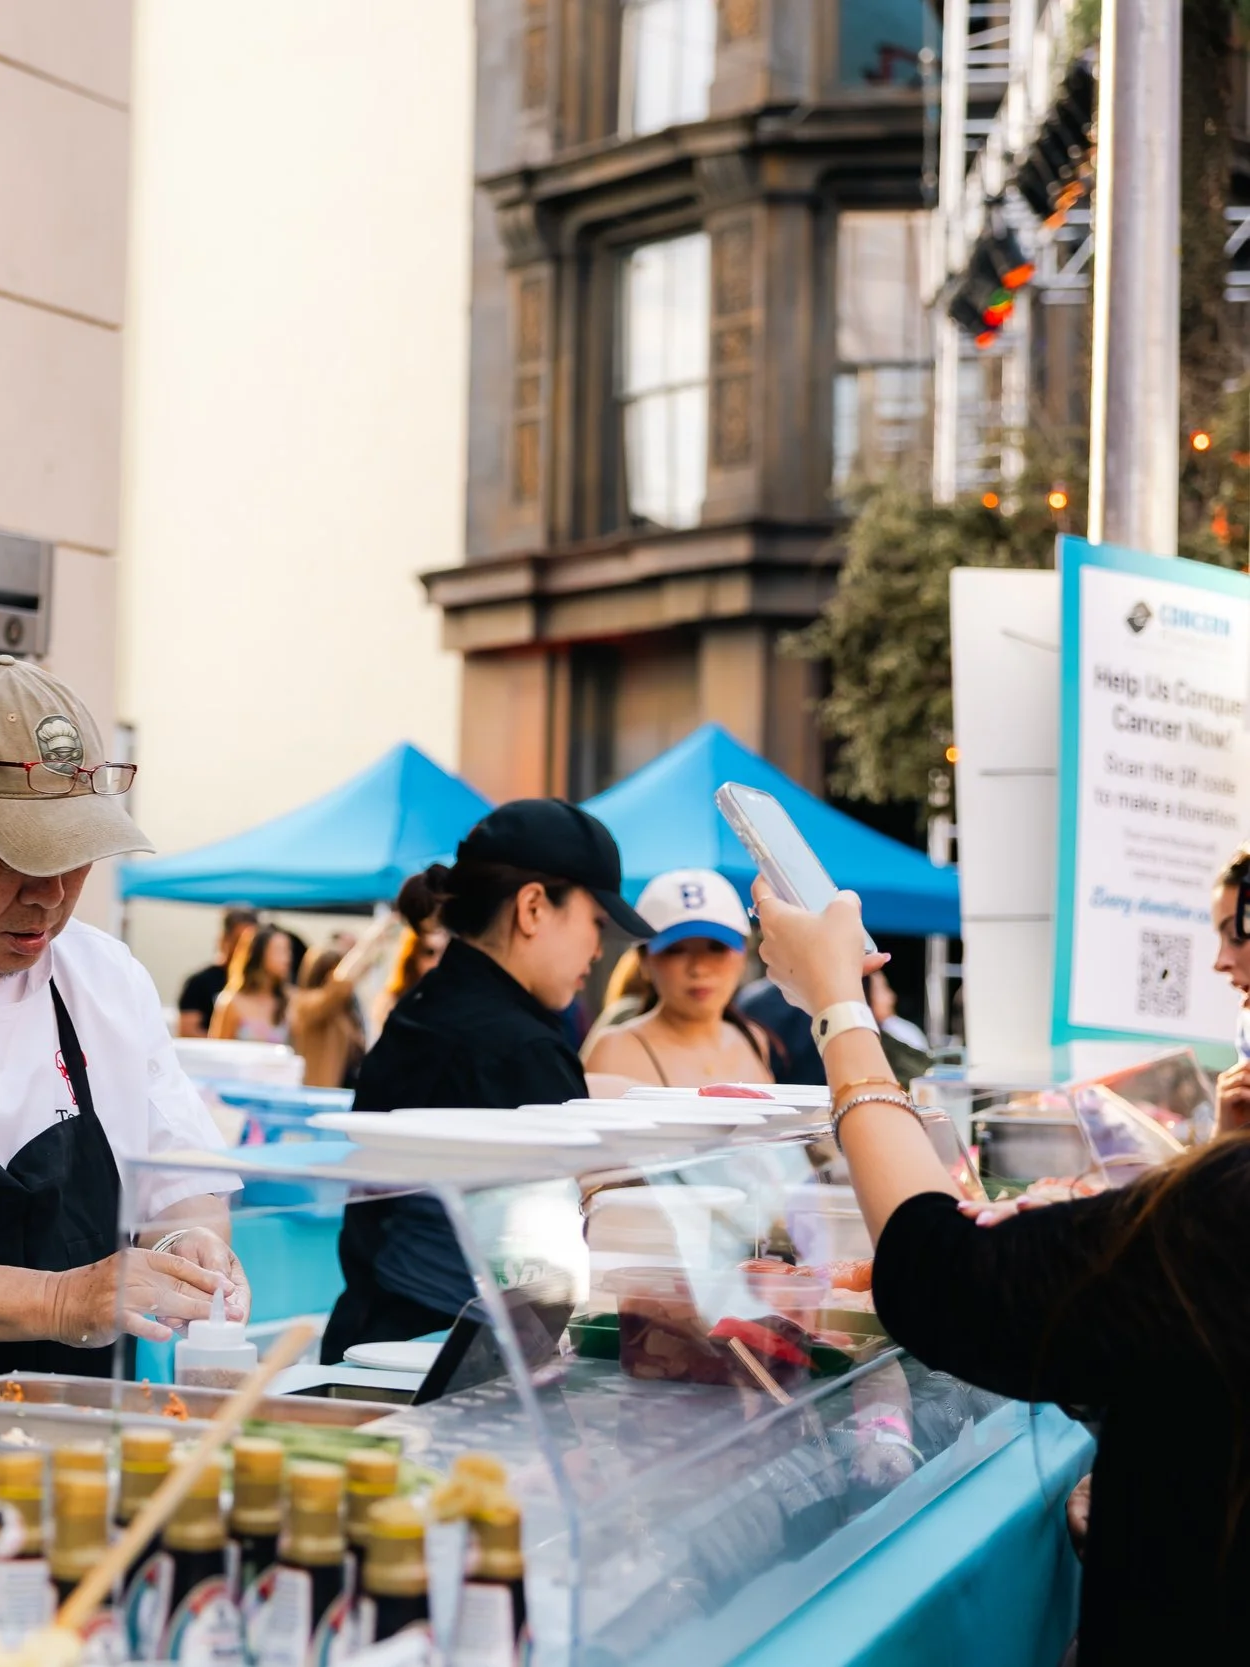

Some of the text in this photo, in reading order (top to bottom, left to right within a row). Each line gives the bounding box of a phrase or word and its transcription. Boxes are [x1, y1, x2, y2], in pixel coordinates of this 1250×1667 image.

[1094, 665, 1243, 717] Help Us Conque
[1112, 703, 1182, 741] Cancer
[1104, 750, 1144, 778] Scan
[1151, 762, 1175, 785] the
[1094, 786, 1110, 807] to
[1117, 792, 1159, 814] make
[679, 883, 707, 910] B
